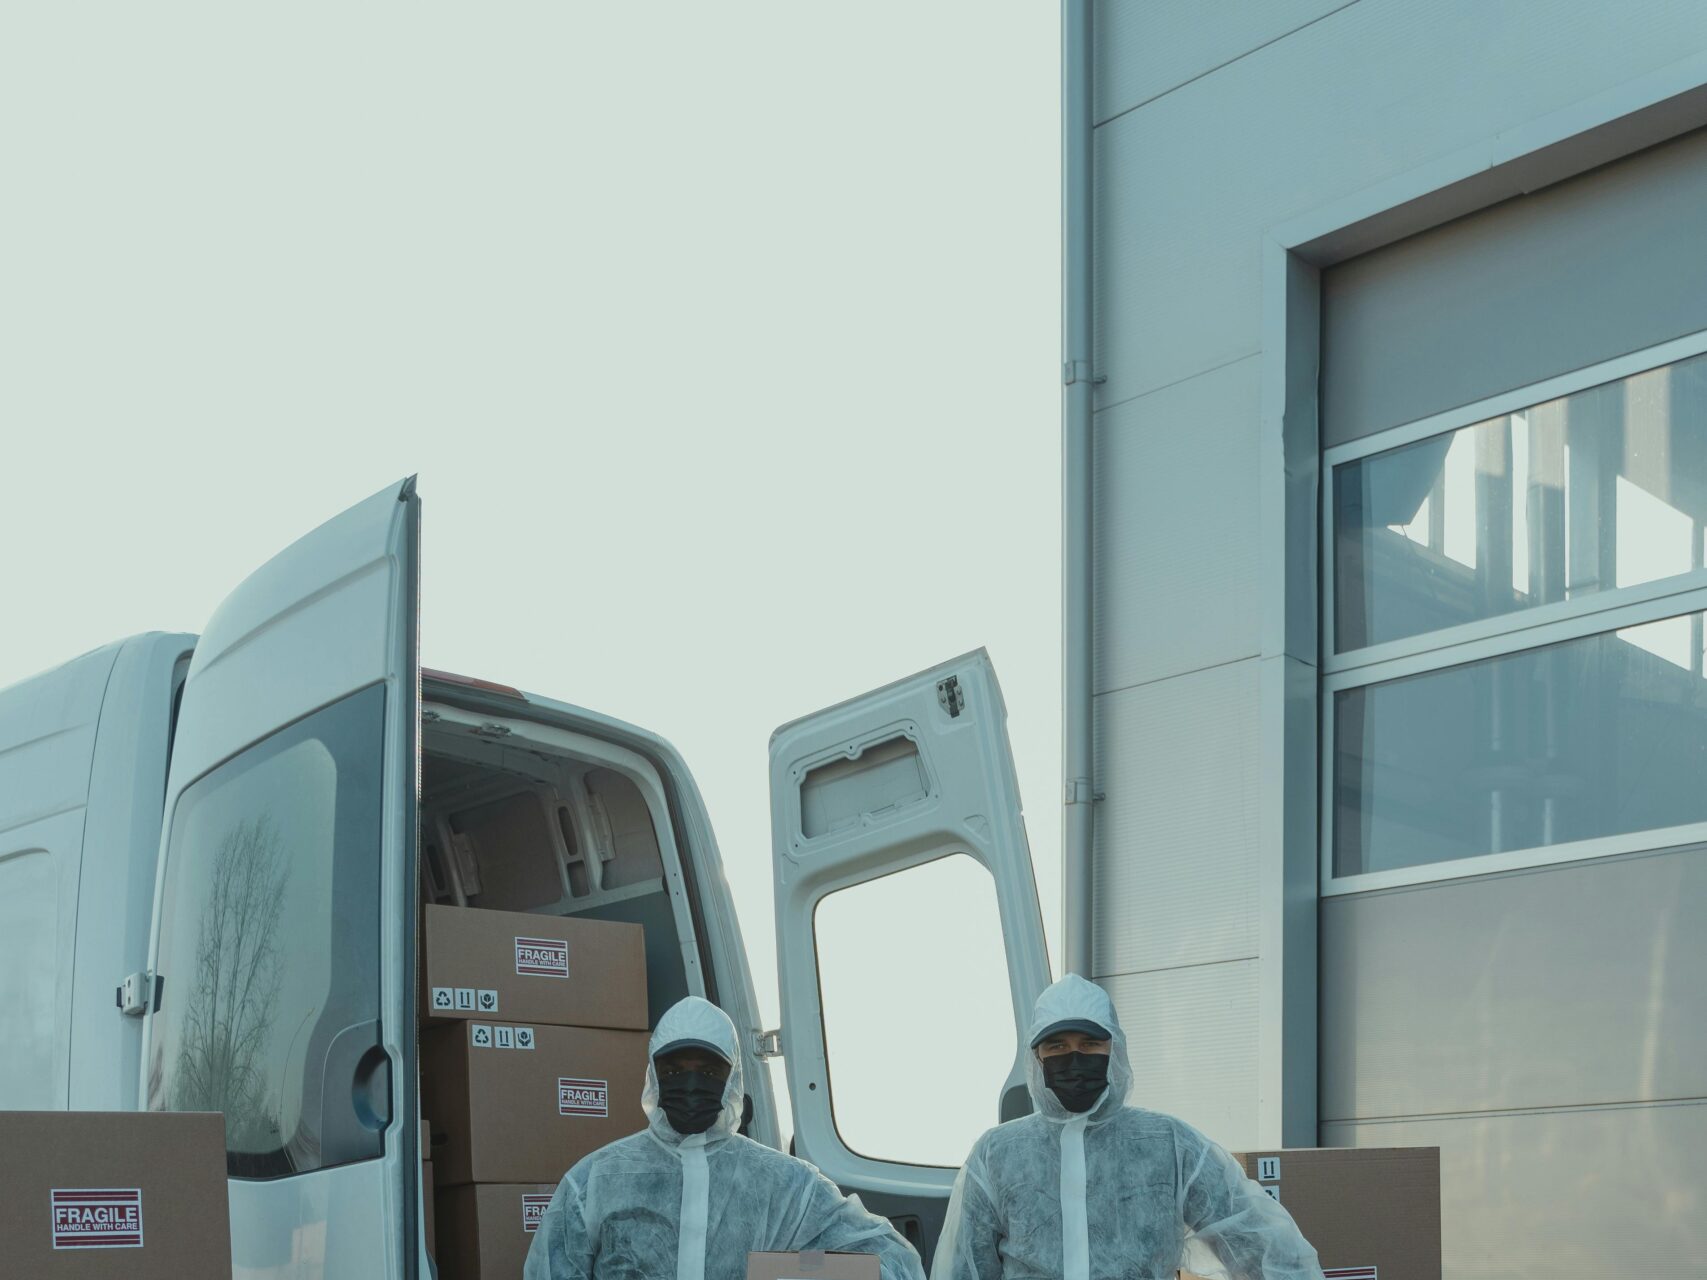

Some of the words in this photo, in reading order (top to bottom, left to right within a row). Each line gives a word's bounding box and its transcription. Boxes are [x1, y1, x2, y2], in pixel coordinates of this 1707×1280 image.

[518, 949, 565, 962] FRAGILE
[561, 1089, 605, 1101] FRAGILE
[55, 1207, 138, 1224] FRAGILE
[57, 1223, 91, 1232] HANDLE
[92, 1223, 114, 1231] WITH
[115, 1222, 138, 1230] CARE
